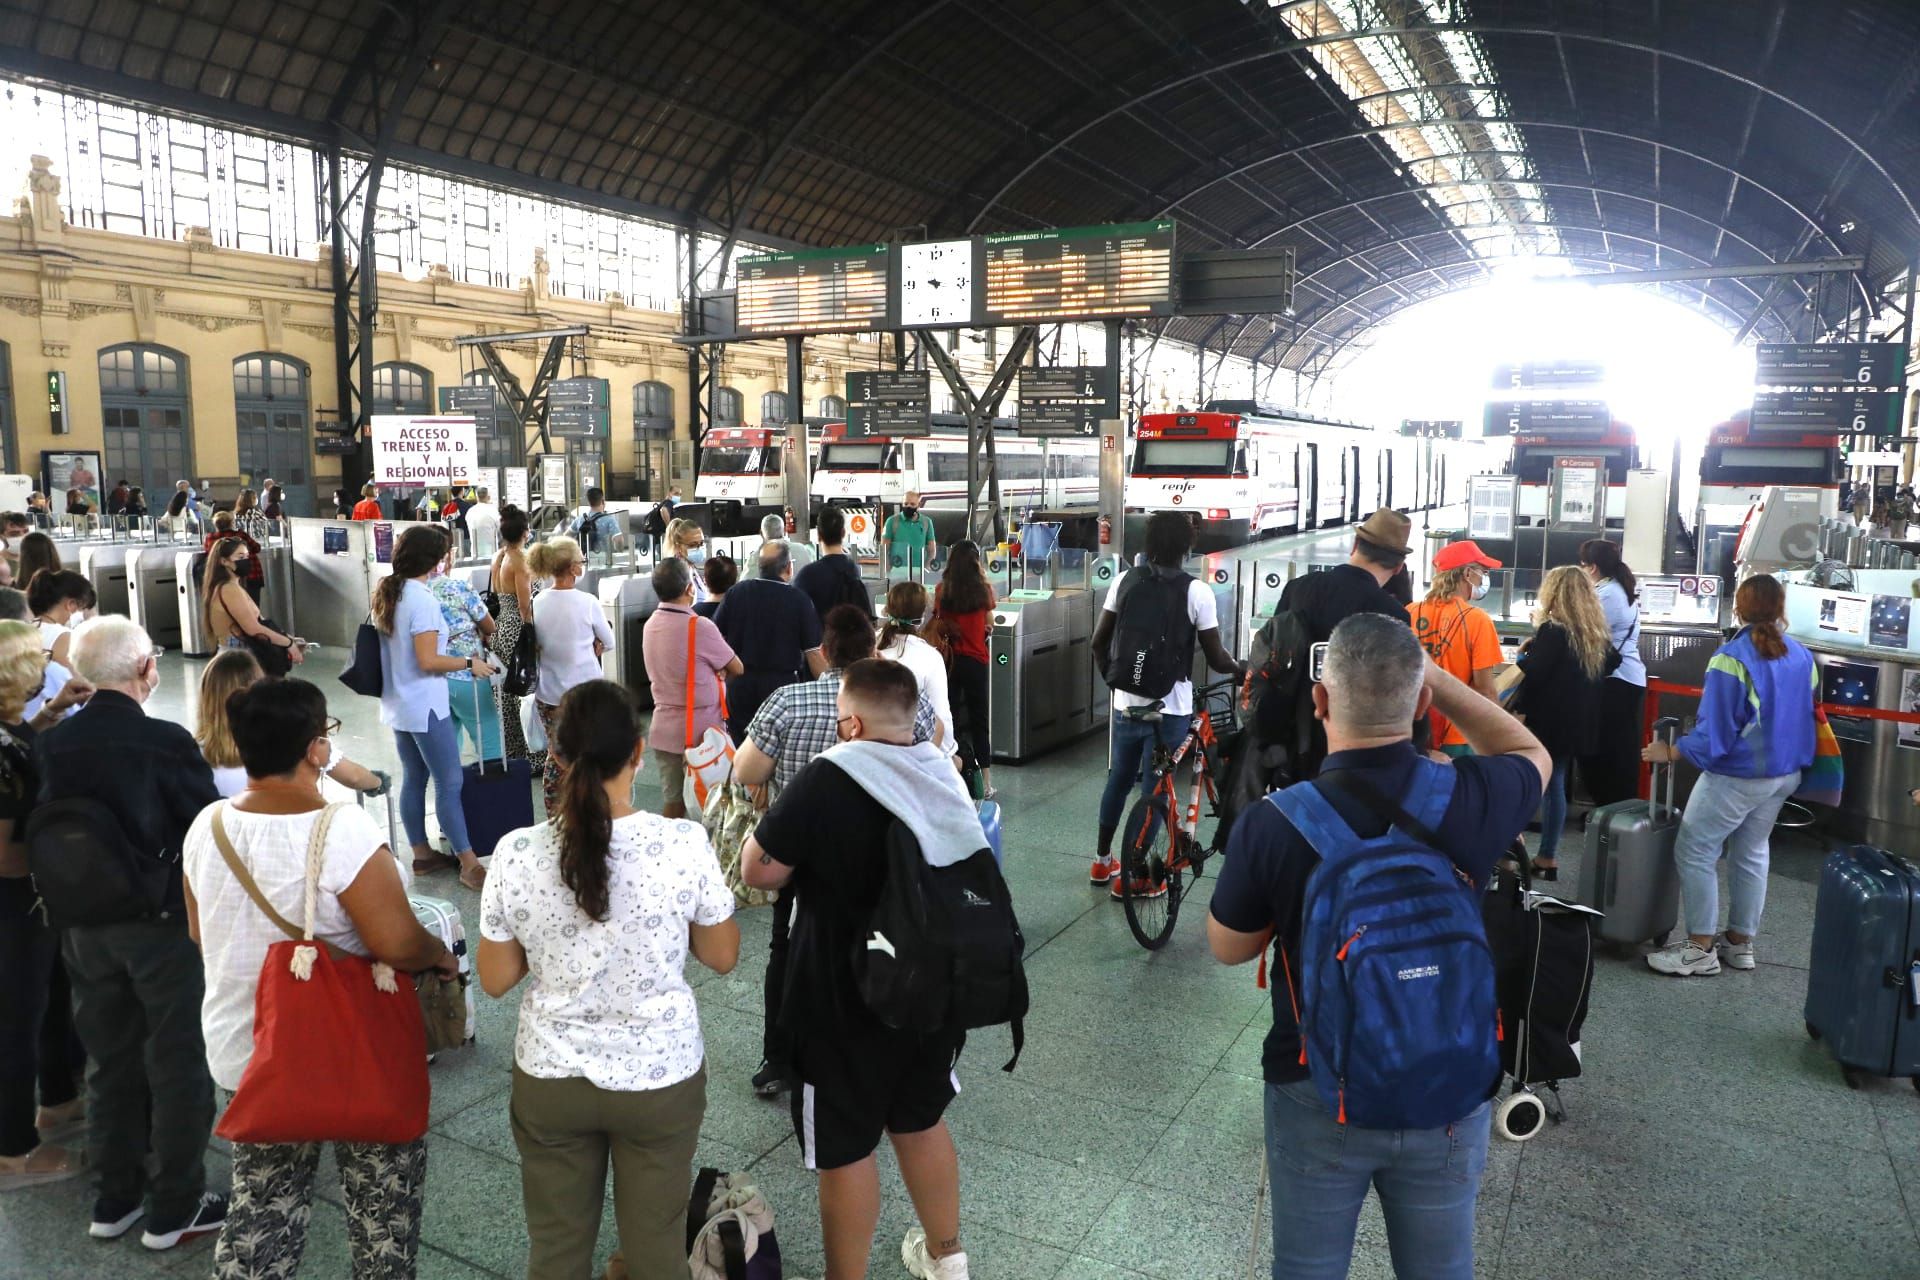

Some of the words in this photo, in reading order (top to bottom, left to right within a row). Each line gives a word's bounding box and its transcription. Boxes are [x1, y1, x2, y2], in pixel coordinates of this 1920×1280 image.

[907, 280, 916, 290] 9
[931, 307, 940, 317] 6
[1858, 366, 1871, 383] 6
[1511, 375, 1521, 390] 5
[863, 388, 871, 400] 3
[1084, 384, 1095, 397] 4
[587, 394, 594, 404] 2
[450, 400, 456, 410] 1
[1084, 421, 1094, 435] 4
[1509, 419, 1520, 434] 5
[1852, 414, 1866, 432] 6
[399, 428, 450, 439] ACCESO
[588, 424, 594, 435] 2
[863, 423, 871, 435] 3
[1139, 430, 1162, 438] 254M
[1717, 435, 1743, 444] 021M
[382, 441, 431, 452] TRENES
[436, 441, 451, 452] M.
[455, 441, 468, 452] D.
[422, 454, 430, 465] Y
[386, 466, 467, 478] REGIONALES
[1161, 481, 1196, 494] renfe
